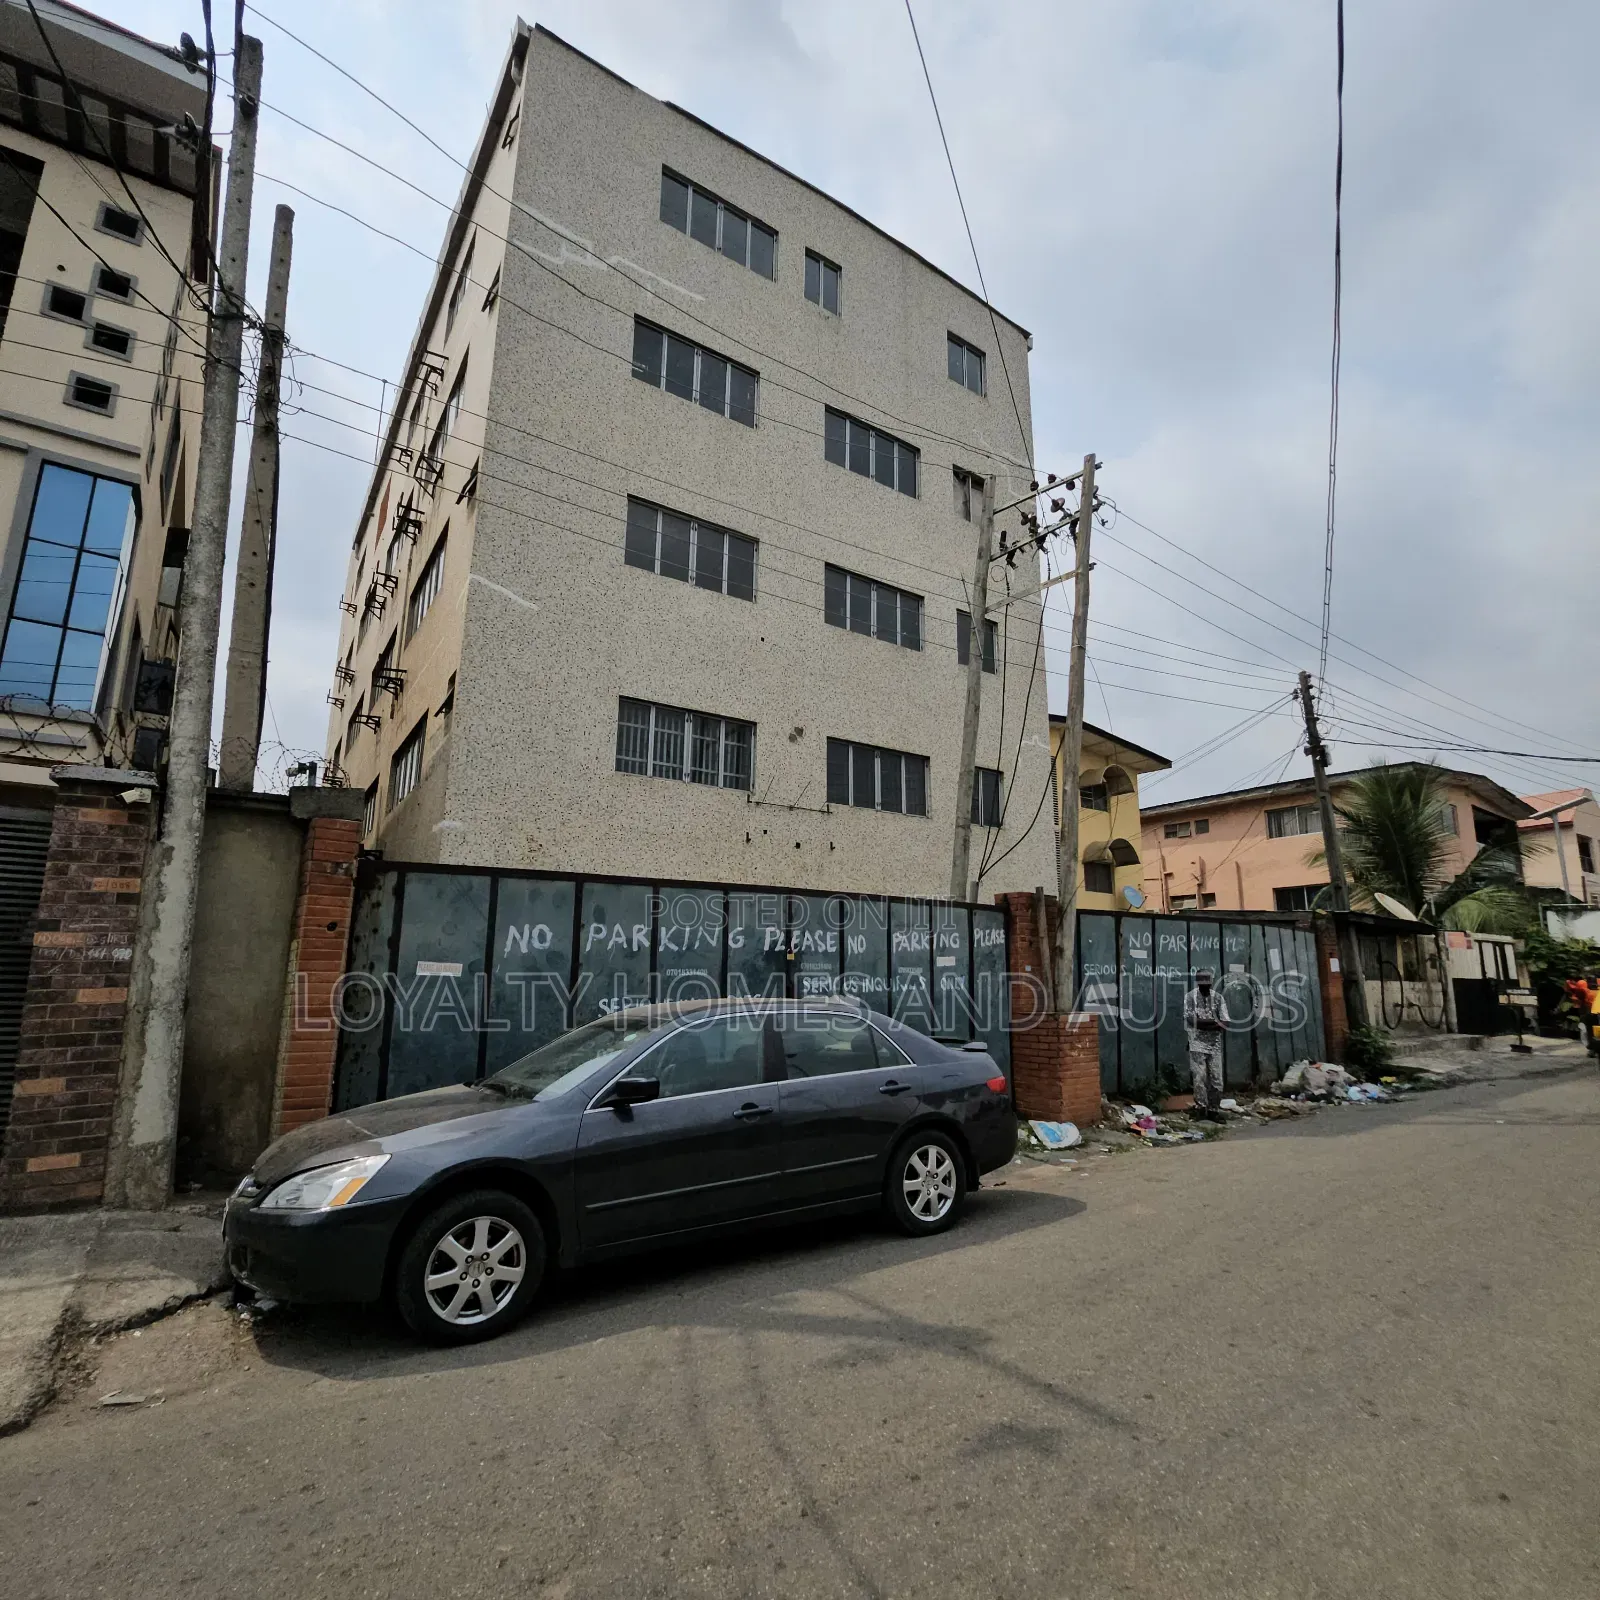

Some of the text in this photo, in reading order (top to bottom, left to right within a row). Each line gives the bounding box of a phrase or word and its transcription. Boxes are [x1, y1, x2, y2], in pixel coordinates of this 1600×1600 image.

[504, 922, 838, 957] NO PARKING PLEASE
[847, 927, 1006, 955] NO PARKING PLEASE
[1129, 932, 1152, 948] NO
[1159, 934, 1220, 952] PARKING
[1084, 963, 1127, 976] SERIOUS
[1190, 965, 1217, 979] OY
